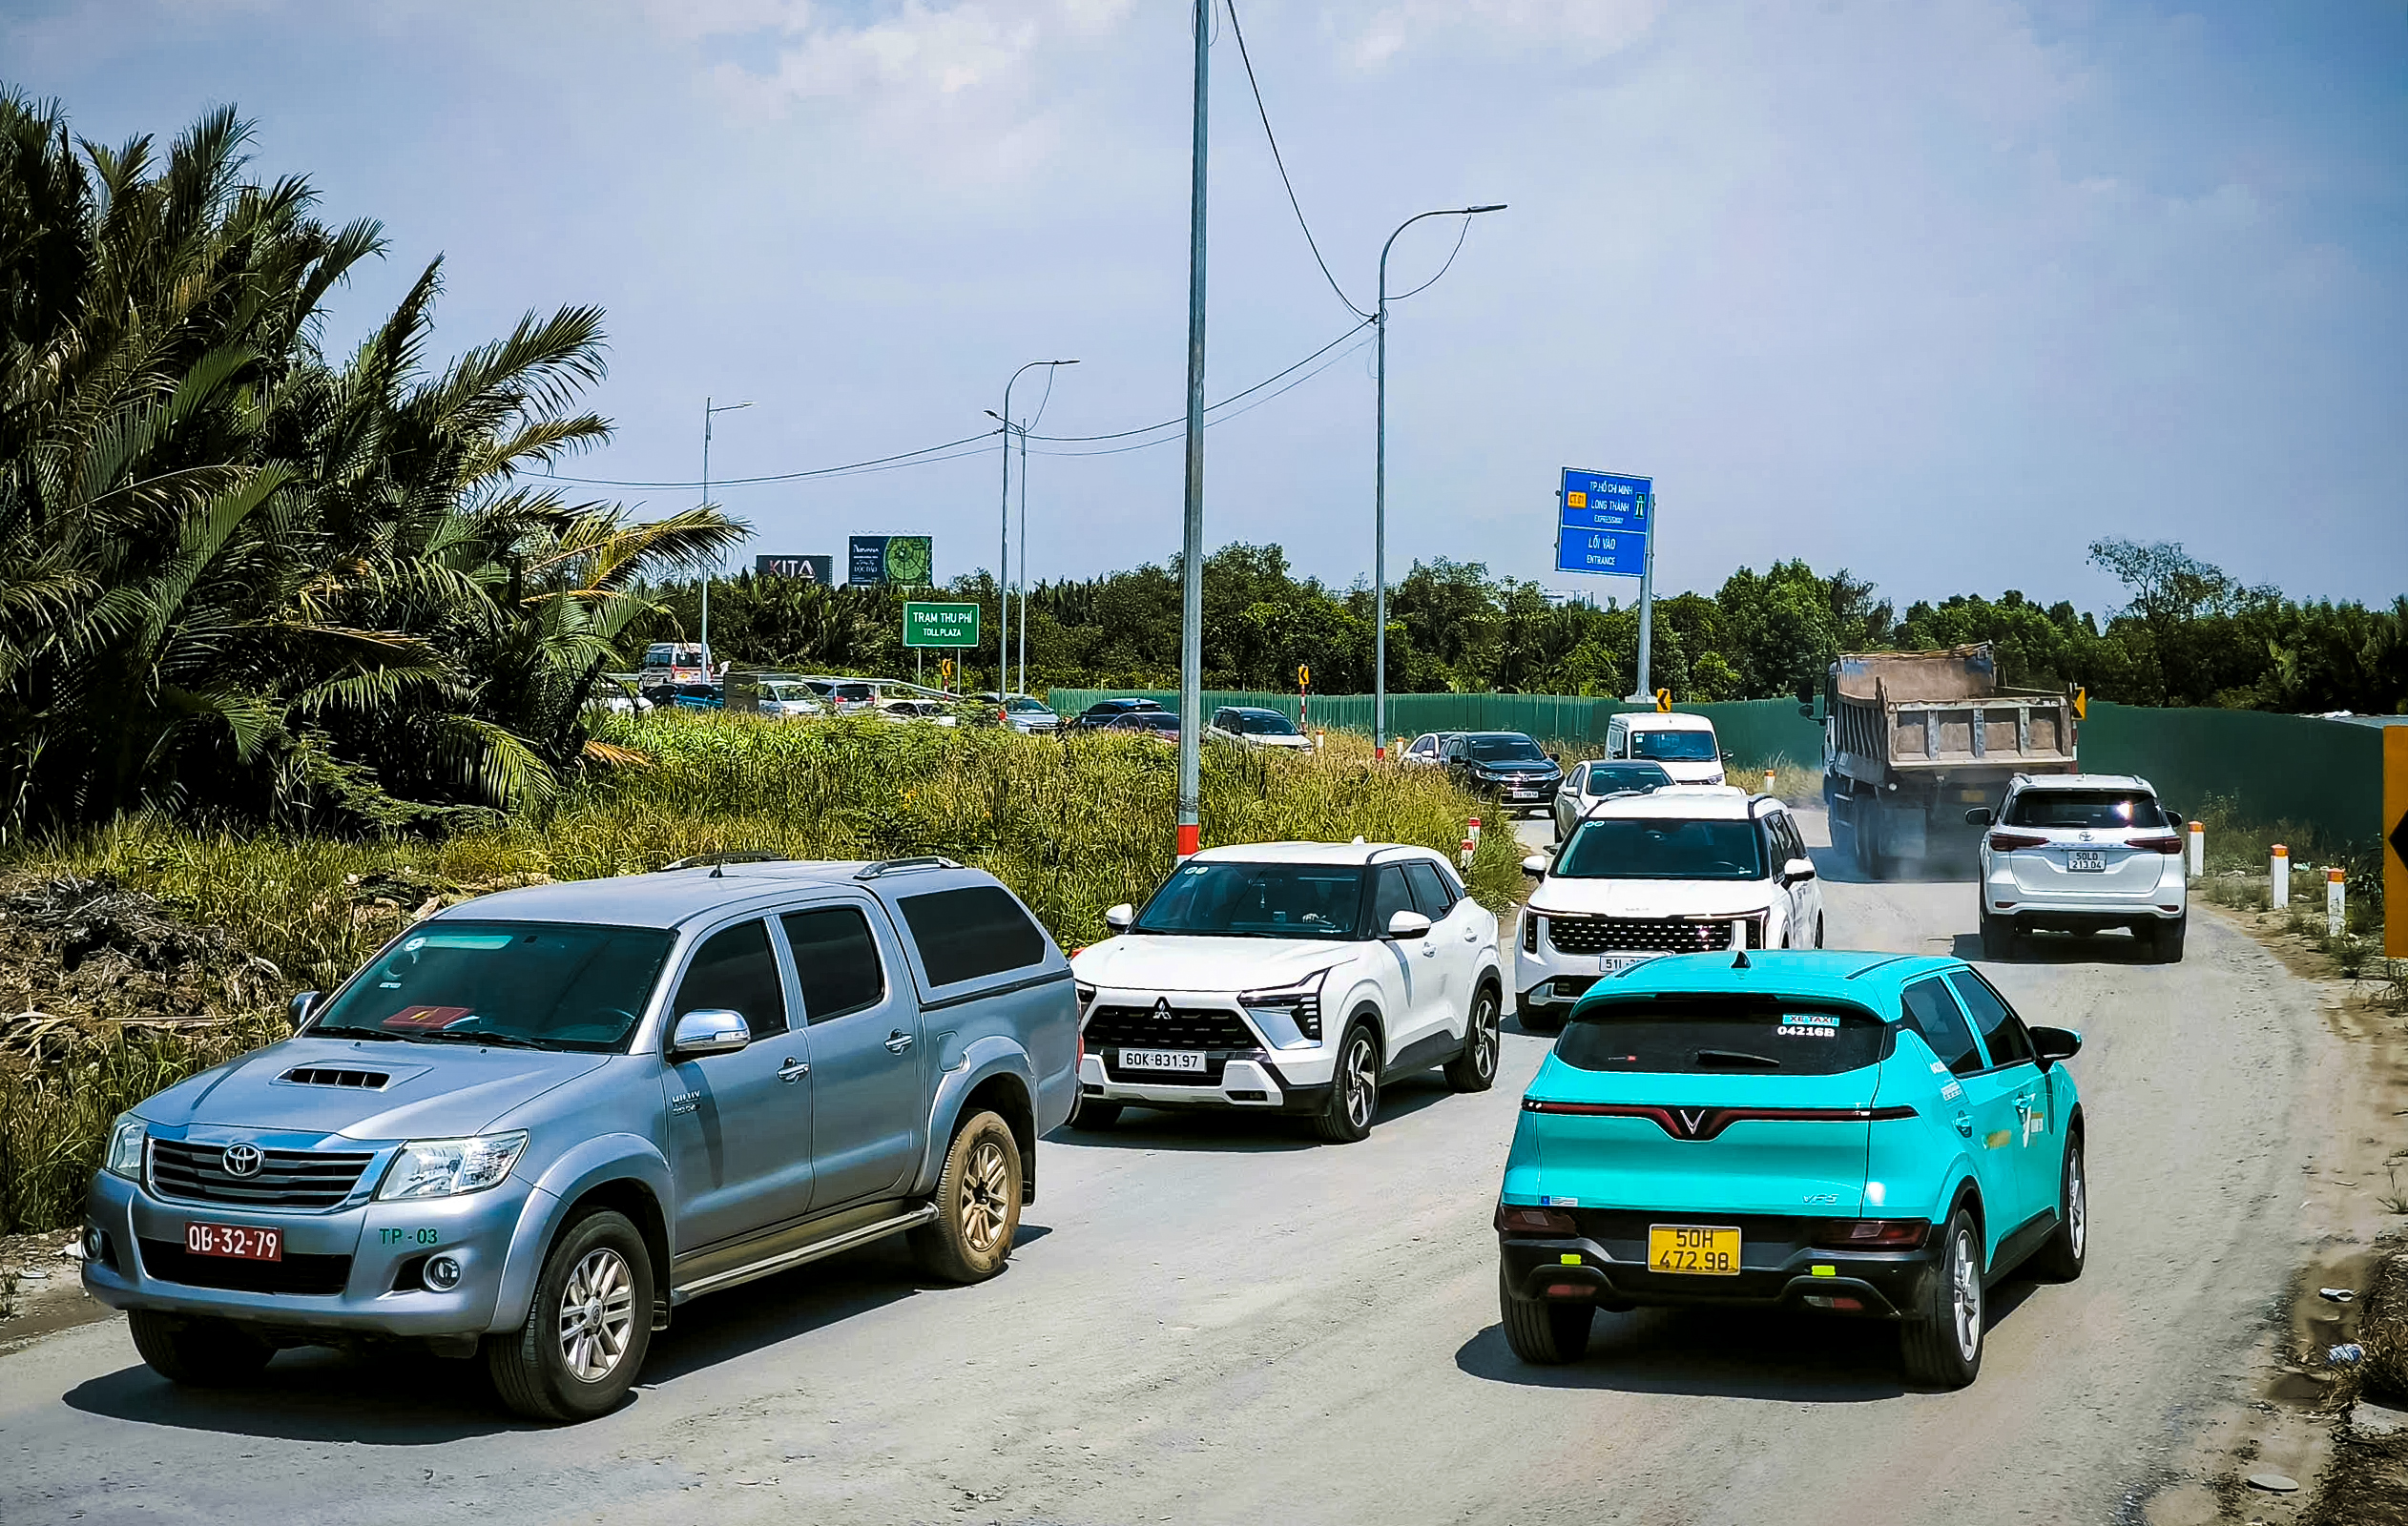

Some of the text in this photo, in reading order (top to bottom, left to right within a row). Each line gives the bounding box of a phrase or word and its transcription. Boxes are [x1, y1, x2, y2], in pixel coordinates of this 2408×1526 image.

[1590, 499, 1630, 512] LONG THÀNH
[1602, 535, 1616, 550] VÀO
[1587, 554, 1616, 566] ENTRANCE
[769, 560, 816, 579] KITA
[913, 610, 973, 626] TRẠM THU PHÍ
[923, 628, 962, 637] TOLL PLAZA
[1791, 1015, 1834, 1025] XE TAXI
[1776, 1025, 1836, 1038] 04216B
[1126, 1052, 1198, 1068] 60K-831.97
[1676, 1228, 1713, 1248] 50H
[1659, 1249, 1729, 1271] 472.98
